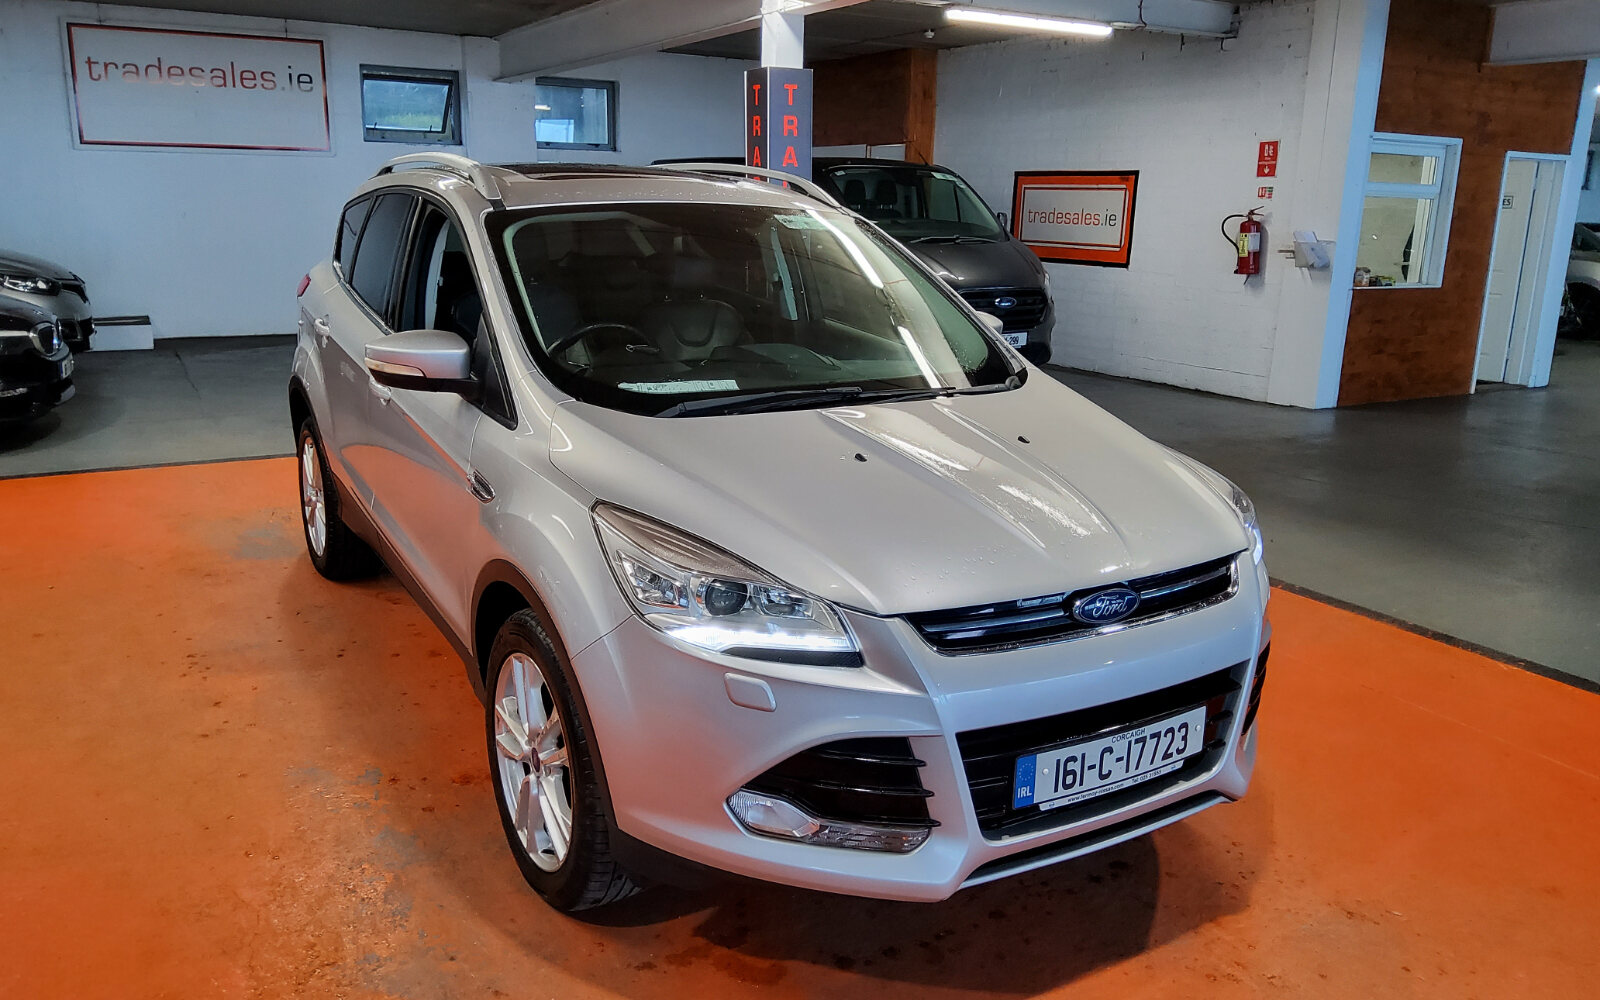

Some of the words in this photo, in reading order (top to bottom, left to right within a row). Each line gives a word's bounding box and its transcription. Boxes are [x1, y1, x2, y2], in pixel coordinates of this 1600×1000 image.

[85, 56, 314, 92] tradesales.ie
[753, 84, 761, 182] TRA
[782, 84, 798, 188] TRA
[1028, 207, 1117, 227] tradesales.ie
[1092, 594, 1129, 618] Ford
[1111, 727, 1146, 744] CORCAIGH
[1053, 721, 1189, 793] 161-C-17723
[1017, 785, 1032, 799] IRL
